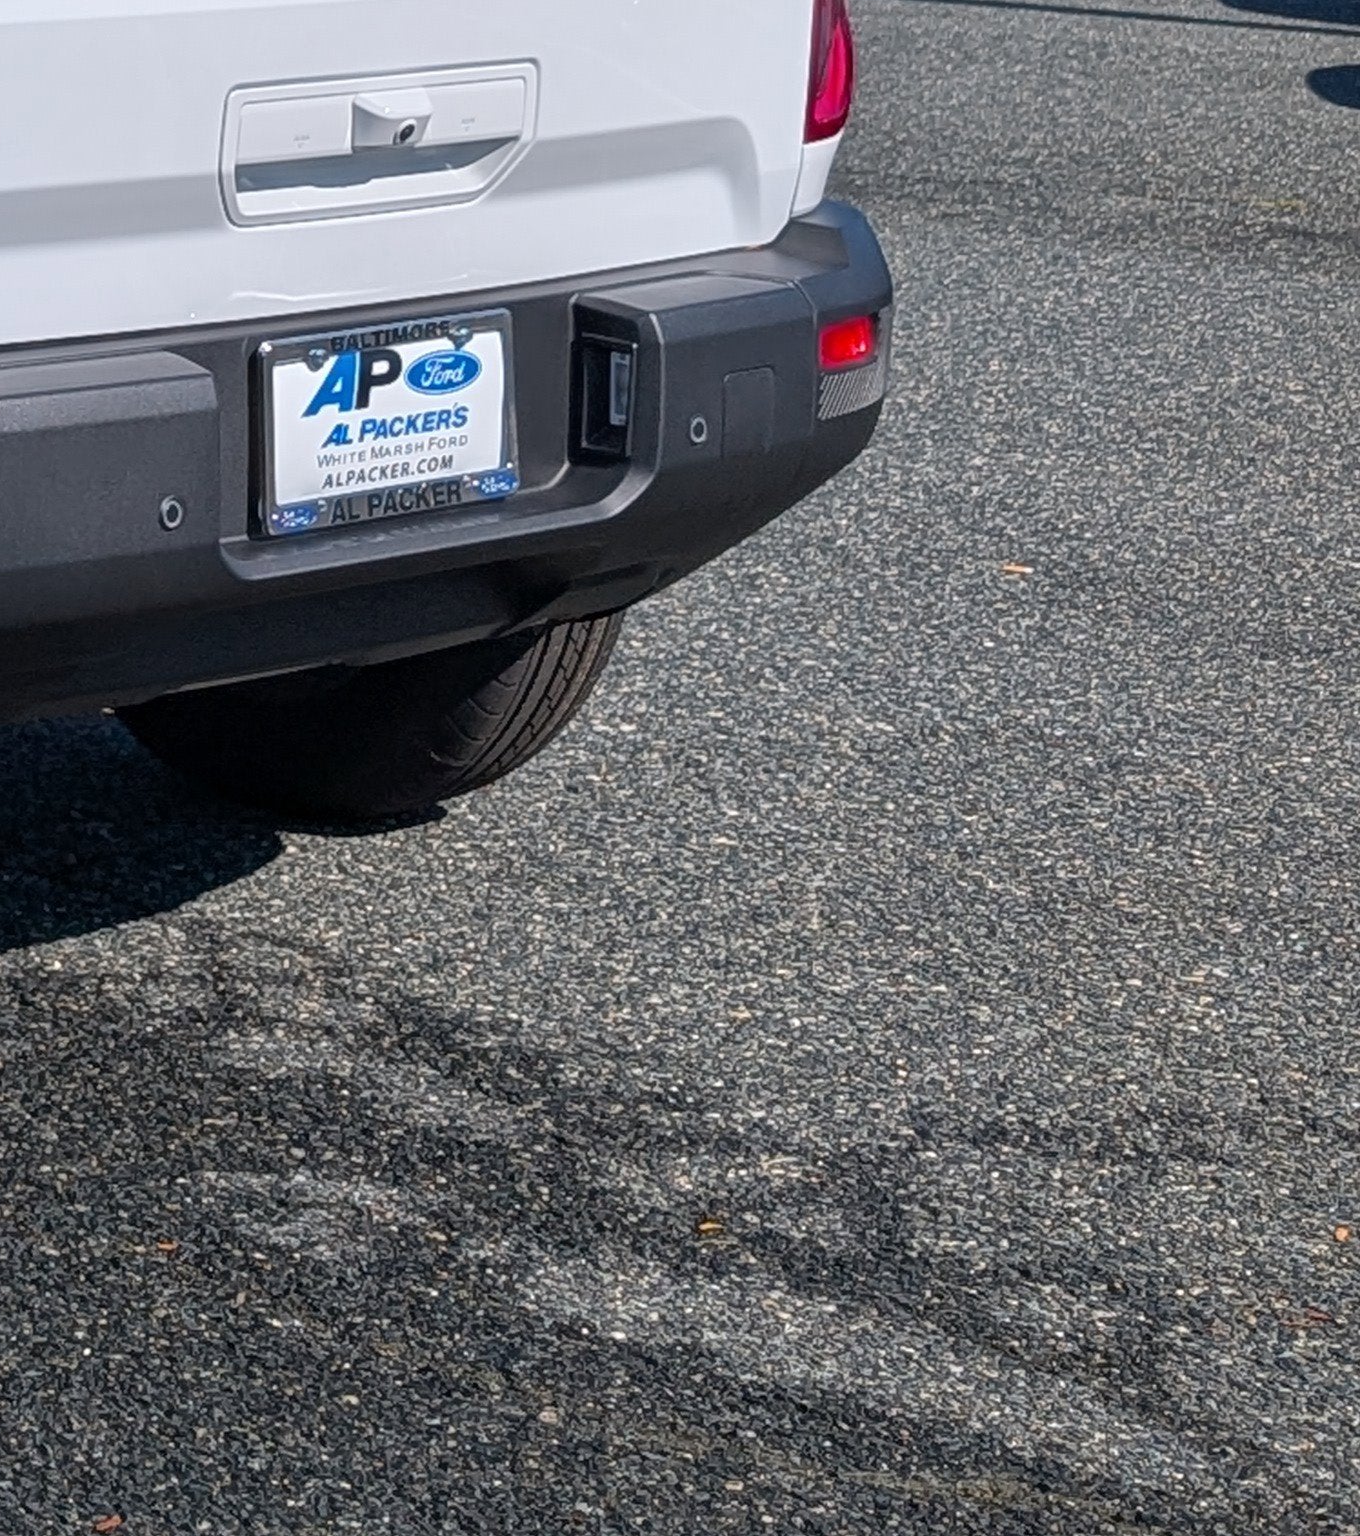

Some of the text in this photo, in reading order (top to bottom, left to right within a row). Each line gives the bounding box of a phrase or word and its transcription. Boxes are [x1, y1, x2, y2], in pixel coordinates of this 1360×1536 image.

[330, 321, 450, 351] BALTIMORE
[301, 348, 466, 418] AP Ford
[321, 402, 470, 449] AL PACKER'S
[317, 433, 469, 469] WHITE MARSH FORD
[321, 454, 454, 490] ALPACKER.COM
[331, 498, 361, 524] AL
[367, 479, 462, 517] PACKER
